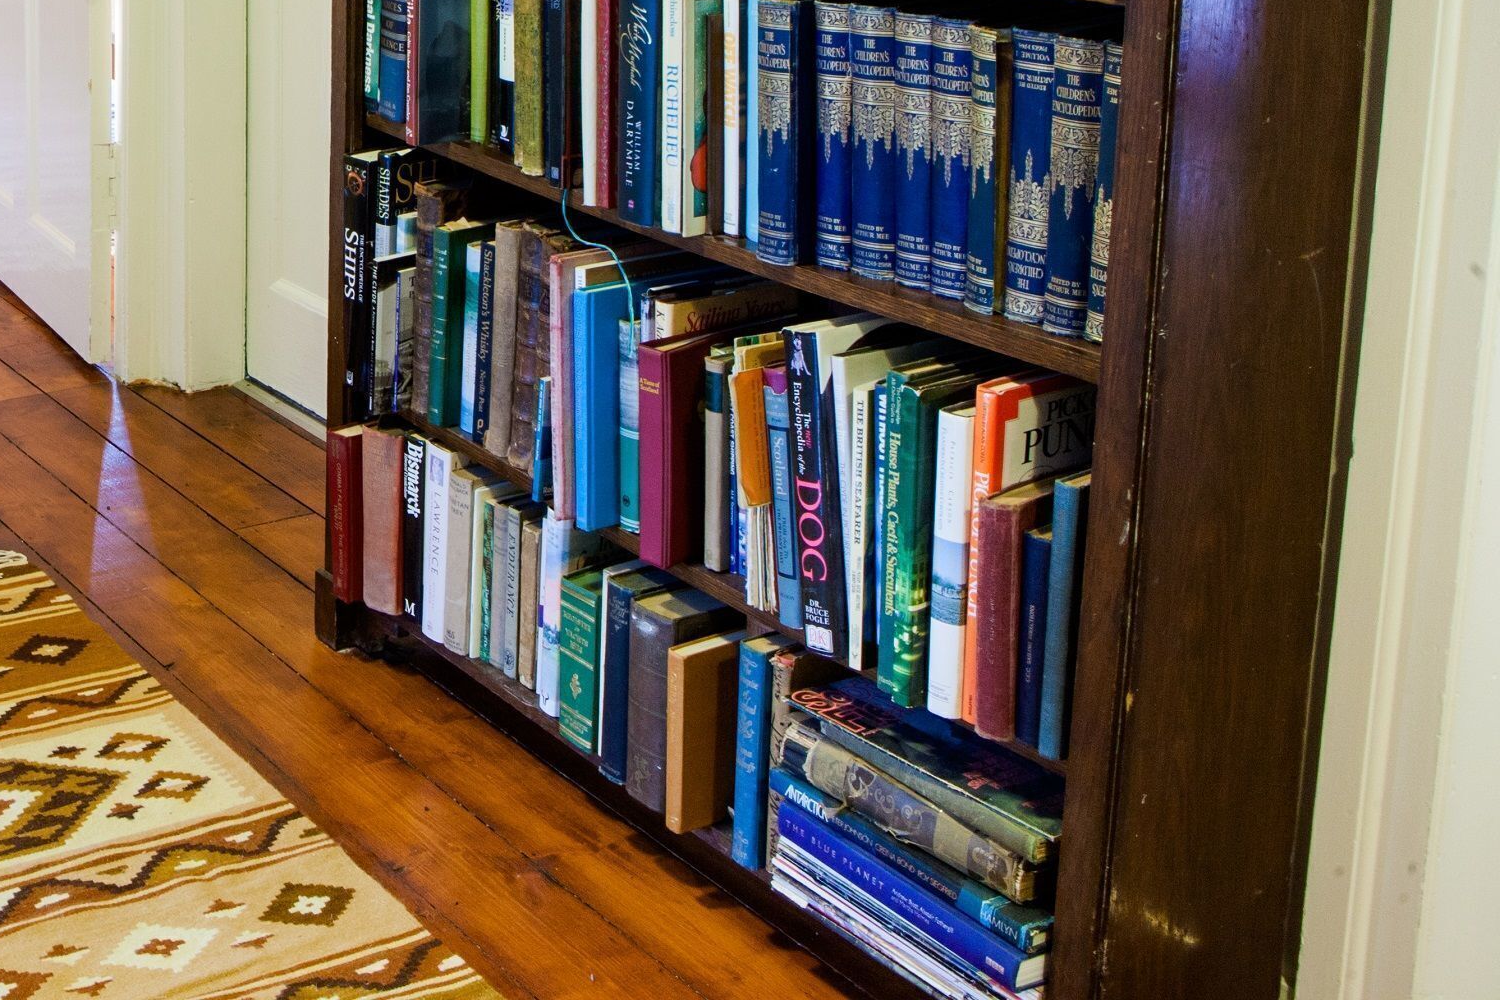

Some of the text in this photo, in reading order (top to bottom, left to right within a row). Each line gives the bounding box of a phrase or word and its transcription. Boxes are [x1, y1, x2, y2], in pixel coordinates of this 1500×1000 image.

[627, 3, 653, 45] White
[764, 31, 775, 42] THE
[821, 33, 833, 44] THE
[863, 38, 876, 49] THE
[364, 22, 375, 94] Darkness
[854, 50, 890, 63] CHILDREN'S
[904, 45, 917, 57] THE
[942, 51, 955, 63] THE
[724, 31, 737, 129] OFF WATCH
[1056, 86, 1096, 102] CHILDREN'S
[1066, 73, 1081, 87] THE
[664, 64, 679, 168] RICHELIEU
[624, 99, 635, 189] DALRYMPLE
[634, 120, 643, 171] WILLIAM
[378, 166, 391, 220] SHADES
[343, 226, 359, 301] SHIPS
[1071, 281, 1081, 289] BY
[478, 248, 493, 395] Shackleton's Whisky Neville
[684, 305, 741, 333] Sailing
[792, 381, 806, 475] Encyclopedia of the
[803, 412, 812, 449] The new
[855, 399, 864, 425] THE
[854, 427, 864, 478] BRITISH
[1021, 414, 1094, 465] PUN
[406, 440, 424, 520] Bismarck
[772, 436, 787, 496] Scotland
[430, 491, 442, 576] LAWRENCE
[795, 475, 828, 582] DOG
[853, 481, 863, 545] SEAFARER
[884, 431, 901, 617] House Plants, Cacti & Succulents
[506, 532, 516, 618] ENDURANCE
[404, 598, 416, 617] M
[804, 605, 830, 618] BRUCE
[804, 613, 830, 625] FOGLE
[808, 598, 822, 609] DR.
[809, 627, 827, 646] DK
[785, 819, 885, 890] THE BLUE PLANET
[843, 823, 874, 847] JOHNSON
[896, 856, 916, 873] BOND
[917, 869, 929, 882] ROY
[980, 906, 1018, 941] HAMLYN
